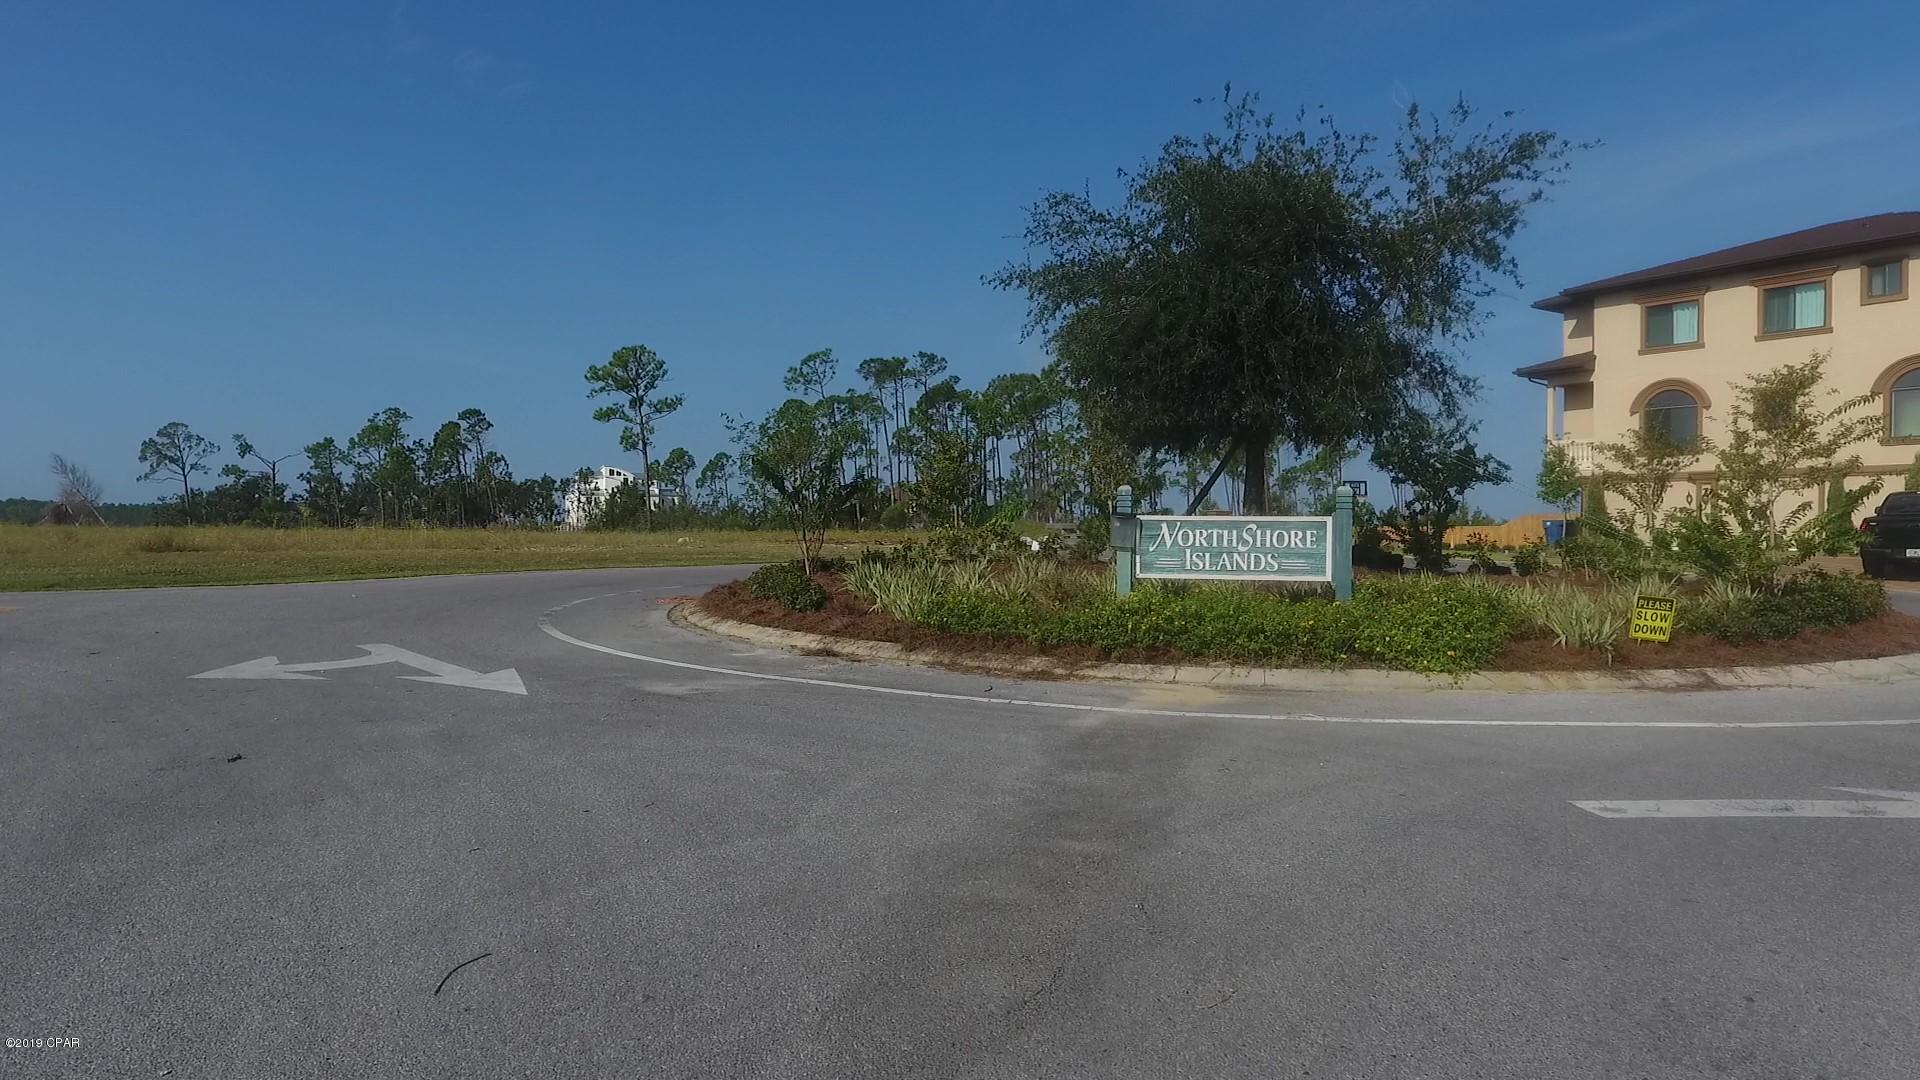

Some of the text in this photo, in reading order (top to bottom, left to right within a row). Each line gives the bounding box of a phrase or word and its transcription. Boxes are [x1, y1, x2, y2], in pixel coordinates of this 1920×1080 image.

[1184, 548, 1279, 572] ISLANDS
[1638, 599, 1673, 611] PLEASE
[1636, 610, 1671, 623] SLOW
[1633, 623, 1667, 636] DOWN
